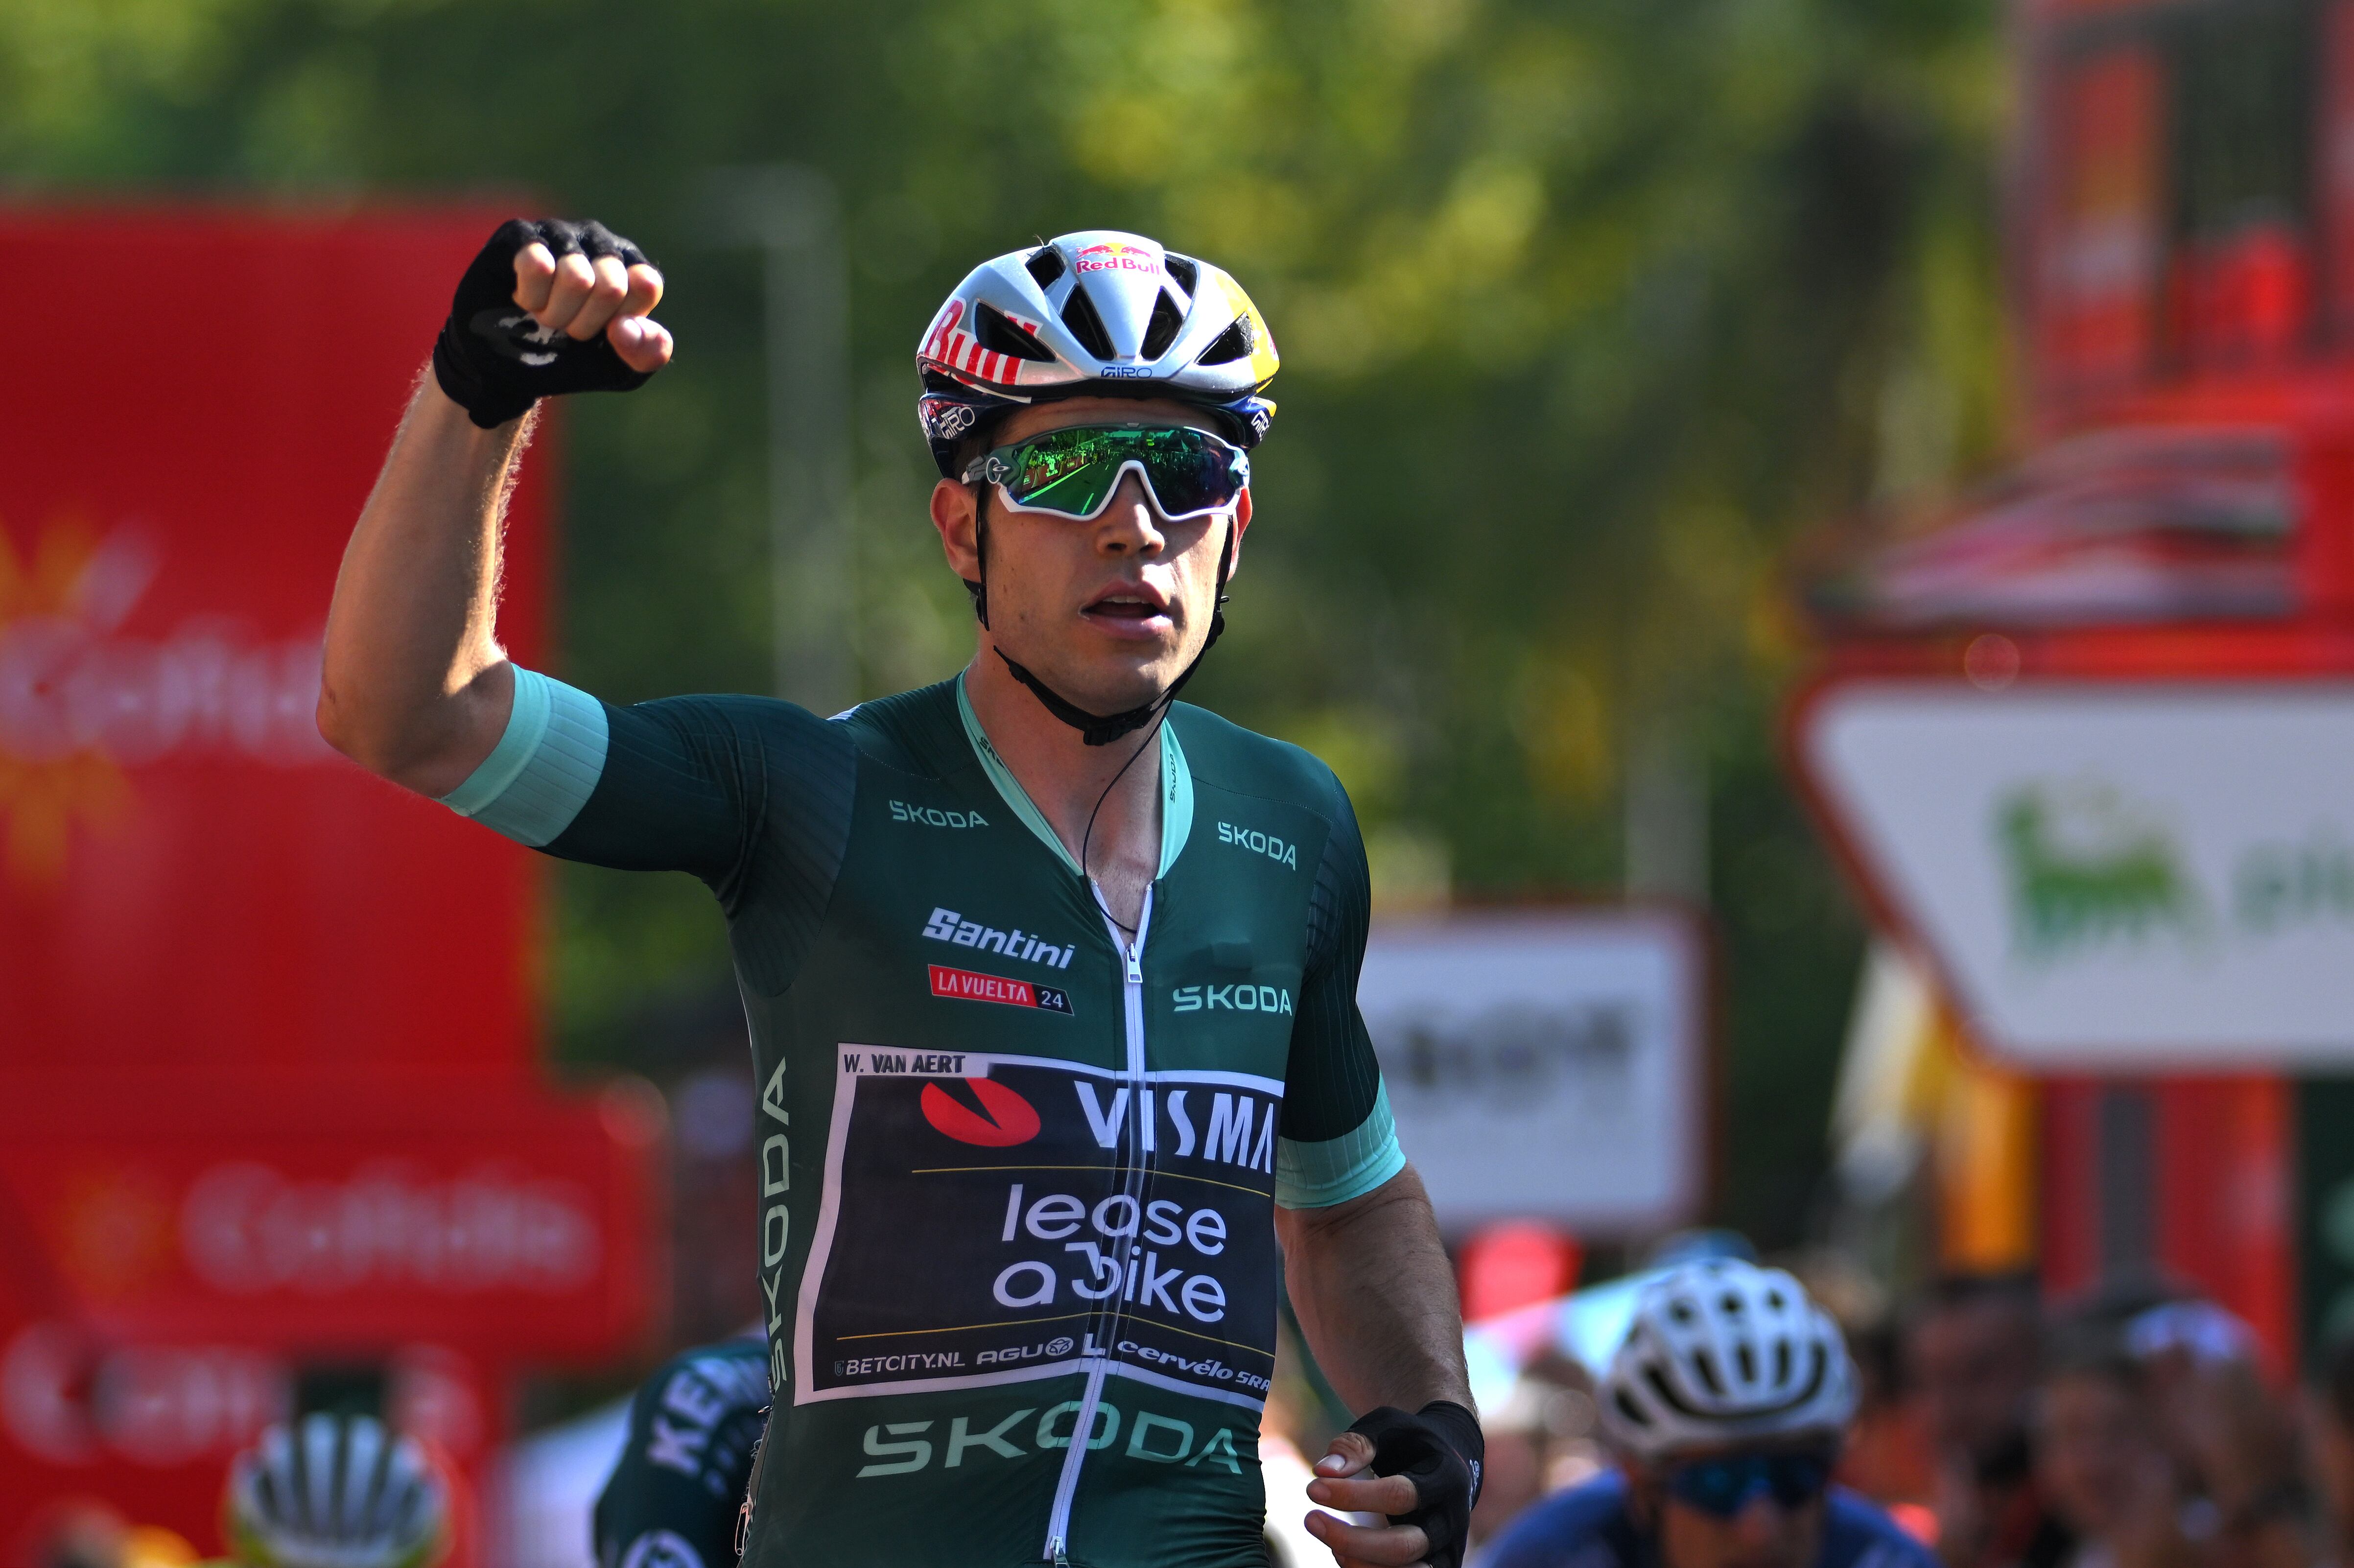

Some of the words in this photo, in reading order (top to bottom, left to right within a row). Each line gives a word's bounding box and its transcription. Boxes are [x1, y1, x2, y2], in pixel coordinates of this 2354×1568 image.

[1076, 257, 1118, 274] Red
[1122, 258, 1160, 276] Bull
[1101, 366, 1153, 378] GIRO
[921, 907, 1076, 969] Santini
[938, 971, 958, 992] LA
[962, 975, 1028, 1002] VUELTA
[1041, 990, 1064, 1008] 24
[844, 1053, 864, 1073] W.
[871, 1053, 907, 1074] VAN
[911, 1054, 966, 1073] AERT
[1074, 1080, 1274, 1174] VISMA
[1002, 1184, 1226, 1256] lease
[992, 1261, 1057, 1308] a
[1064, 1241, 1226, 1323] bike
[846, 1352, 965, 1376] BETCITY.NL
[976, 1344, 1044, 1365] AGU
[1117, 1340, 1234, 1380] cervélo
